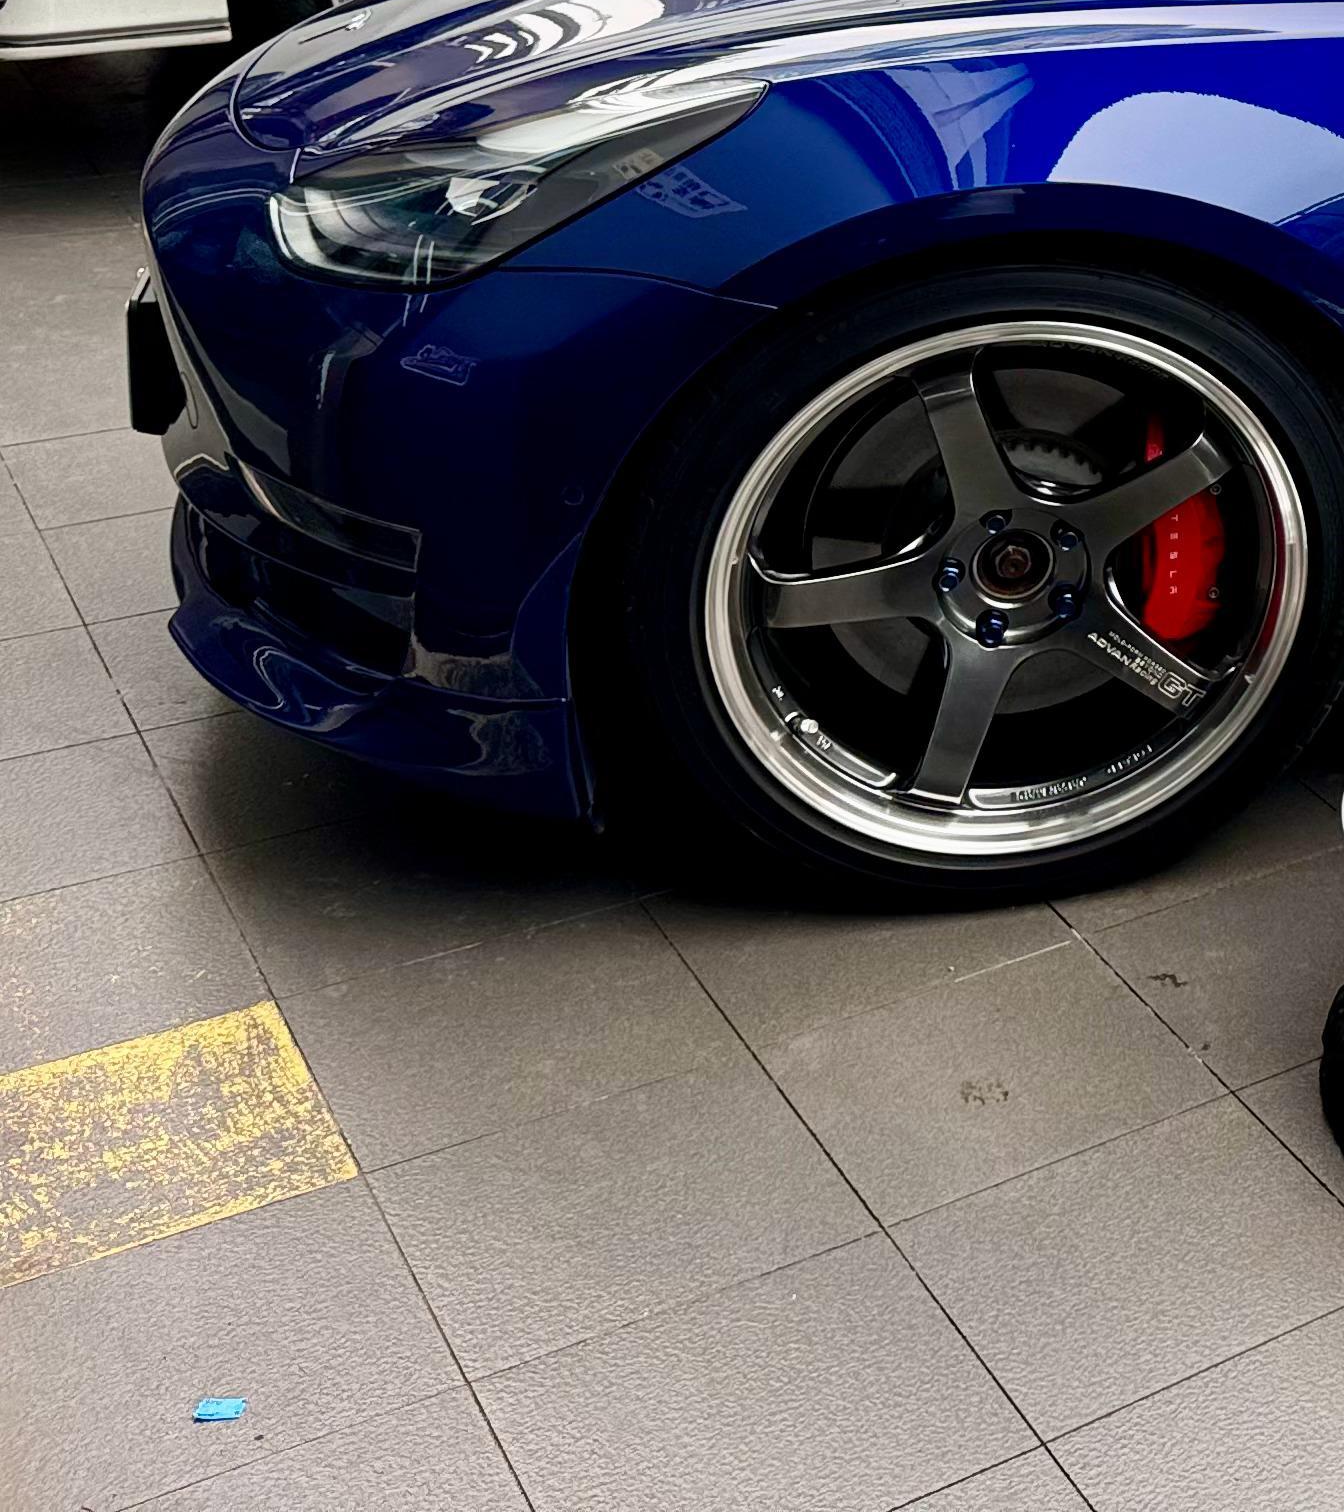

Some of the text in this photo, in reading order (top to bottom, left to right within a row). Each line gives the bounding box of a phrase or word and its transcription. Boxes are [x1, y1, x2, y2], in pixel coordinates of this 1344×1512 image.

[1169, 514, 1179, 595] TESLA
[1087, 632, 1132, 666] ADVAN
[1158, 671, 1207, 707] GT
